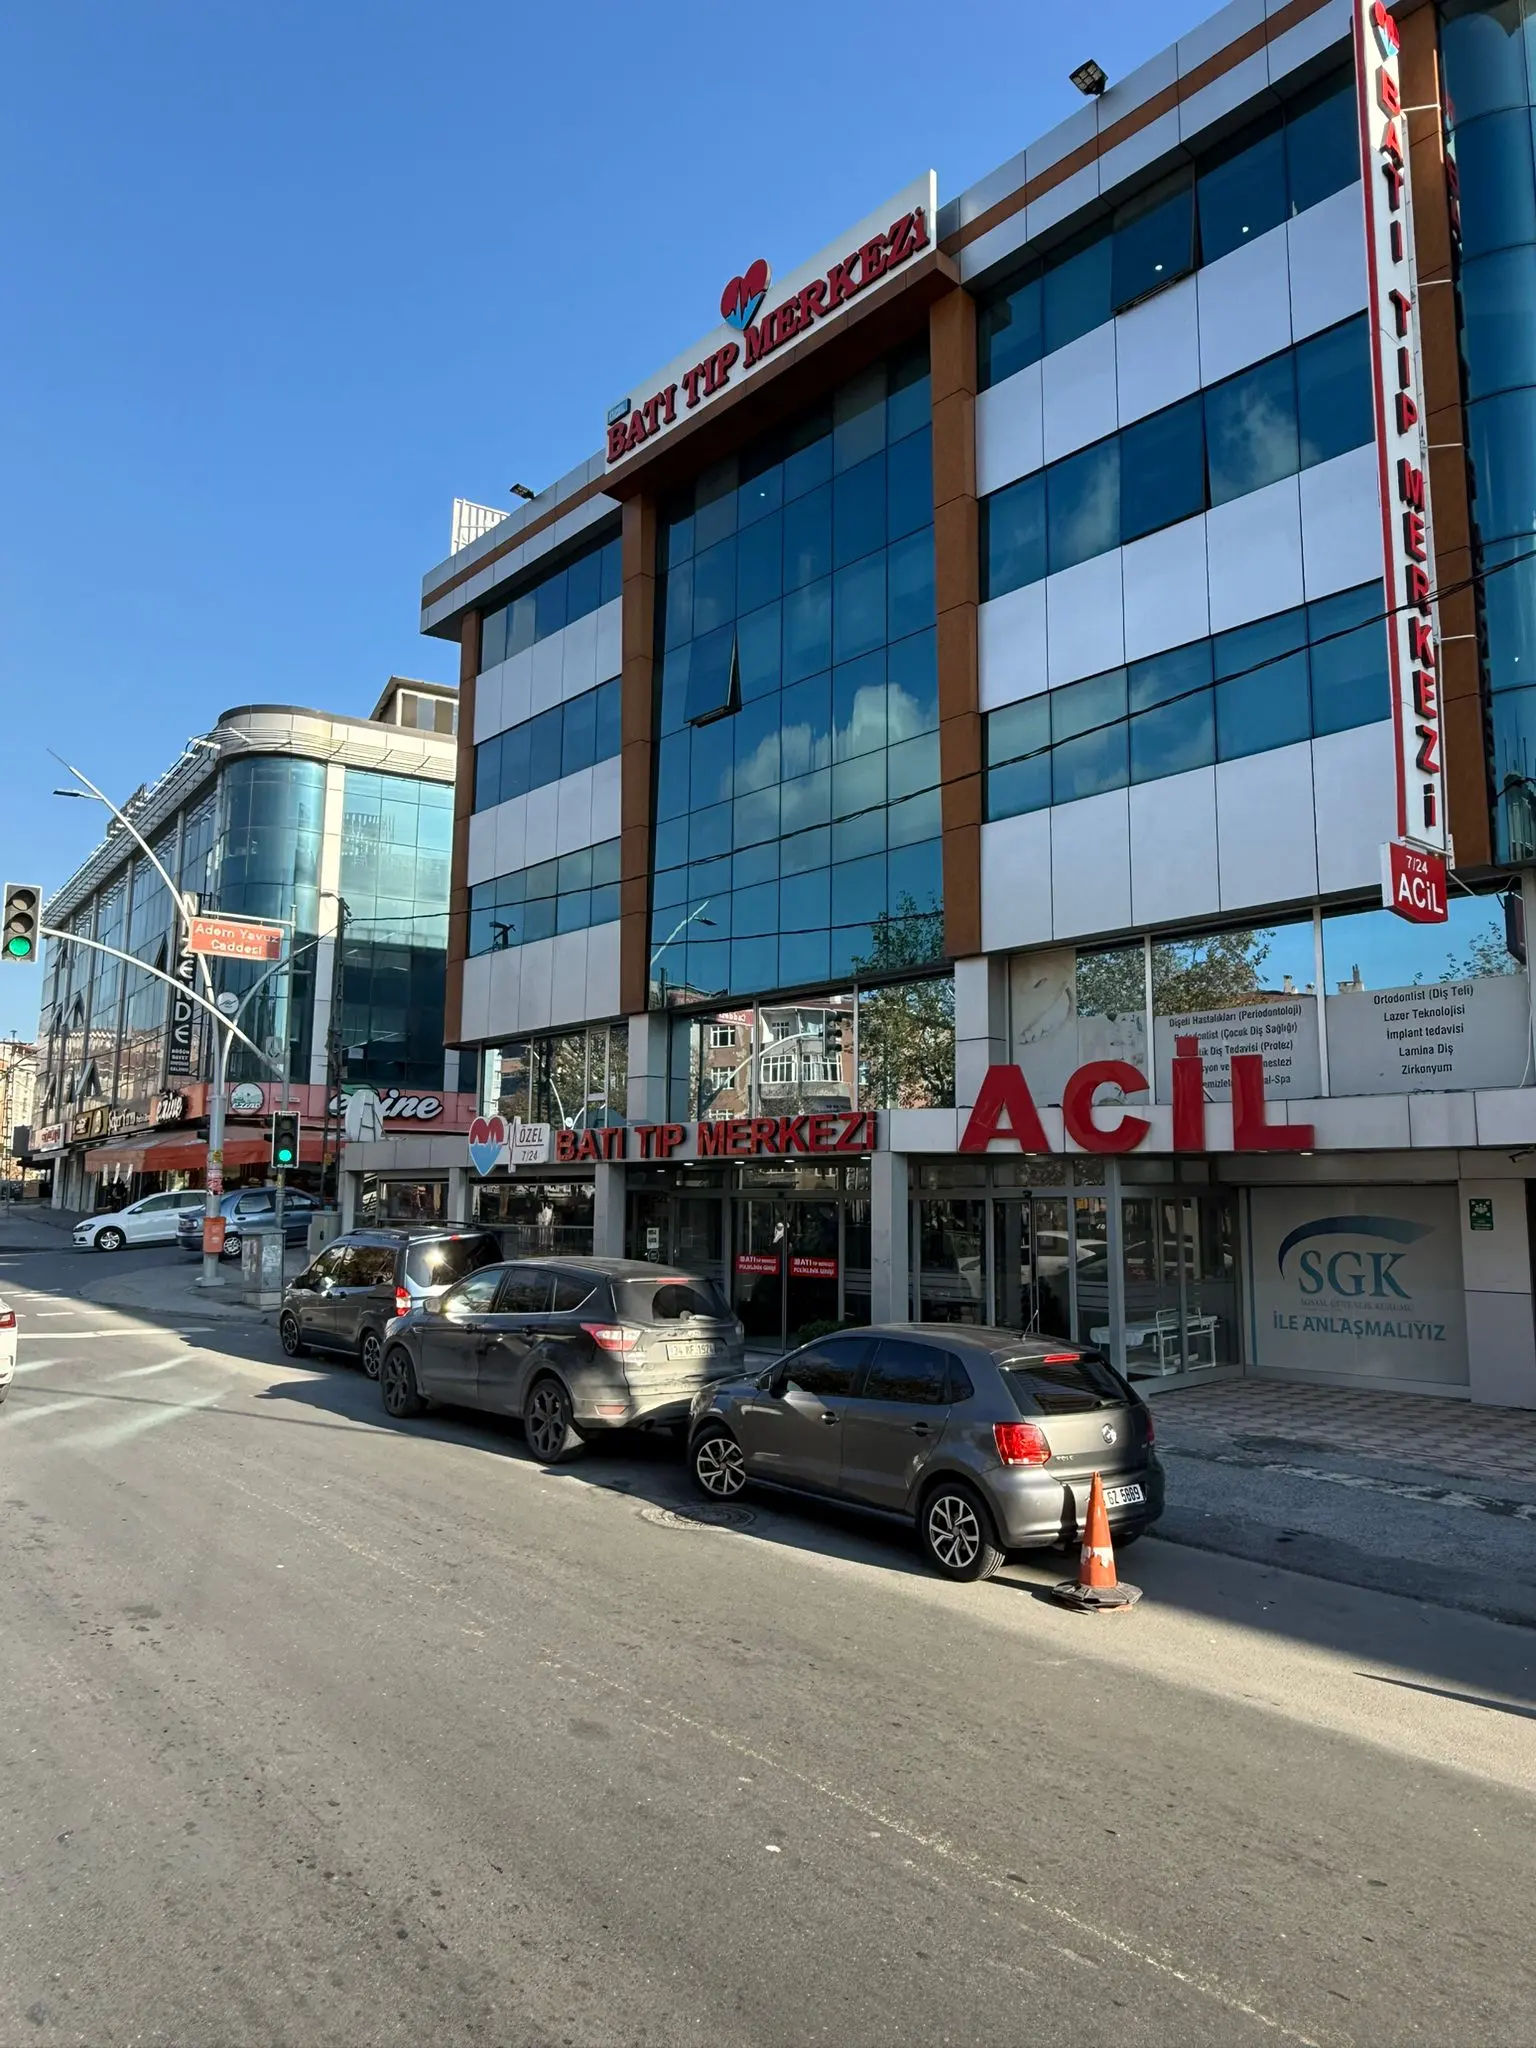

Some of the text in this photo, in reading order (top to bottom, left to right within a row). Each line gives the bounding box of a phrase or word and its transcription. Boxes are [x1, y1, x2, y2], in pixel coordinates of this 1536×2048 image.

[1376, 66, 1404, 263] BATI
[1389, 287, 1418, 437] TIP
[606, 384, 677, 464] BATI
[681, 342, 740, 408] TIP
[1405, 855, 1429, 875] 7/24
[194, 923, 281, 943] Adem Yavuz
[210, 939, 263, 955] Caddesi
[1373, 984, 1474, 1005] Ortodontist (Diş Teli)
[1383, 1004, 1465, 1022] Lazer Teknolojisi
[1220, 1026, 1249, 1040] (Çocuk
[1250, 1025, 1263, 1037] Diş
[1425, 1022, 1464, 1037] tedavisi
[1210, 1046, 1223, 1057] Diş
[1225, 1042, 1259, 1055] Tedavisi
[1398, 1043, 1454, 1057] Lamina Diş
[1220, 1061, 1230, 1071] ve
[1401, 1063, 1453, 1075] Zirkonyum
[329, 1088, 443, 1120] eine
[959, 1036, 1316, 1153] ACİL
[520, 1125, 543, 1143] ÖZEL
[555, 1127, 627, 1162] BATI
[634, 1123, 687, 1158] TIP
[522, 1150, 538, 1161] 7/24
[1299, 1250, 1412, 1299] SGK
[1273, 1311, 1447, 1341] İLE ANLAŞMALIYIZ
